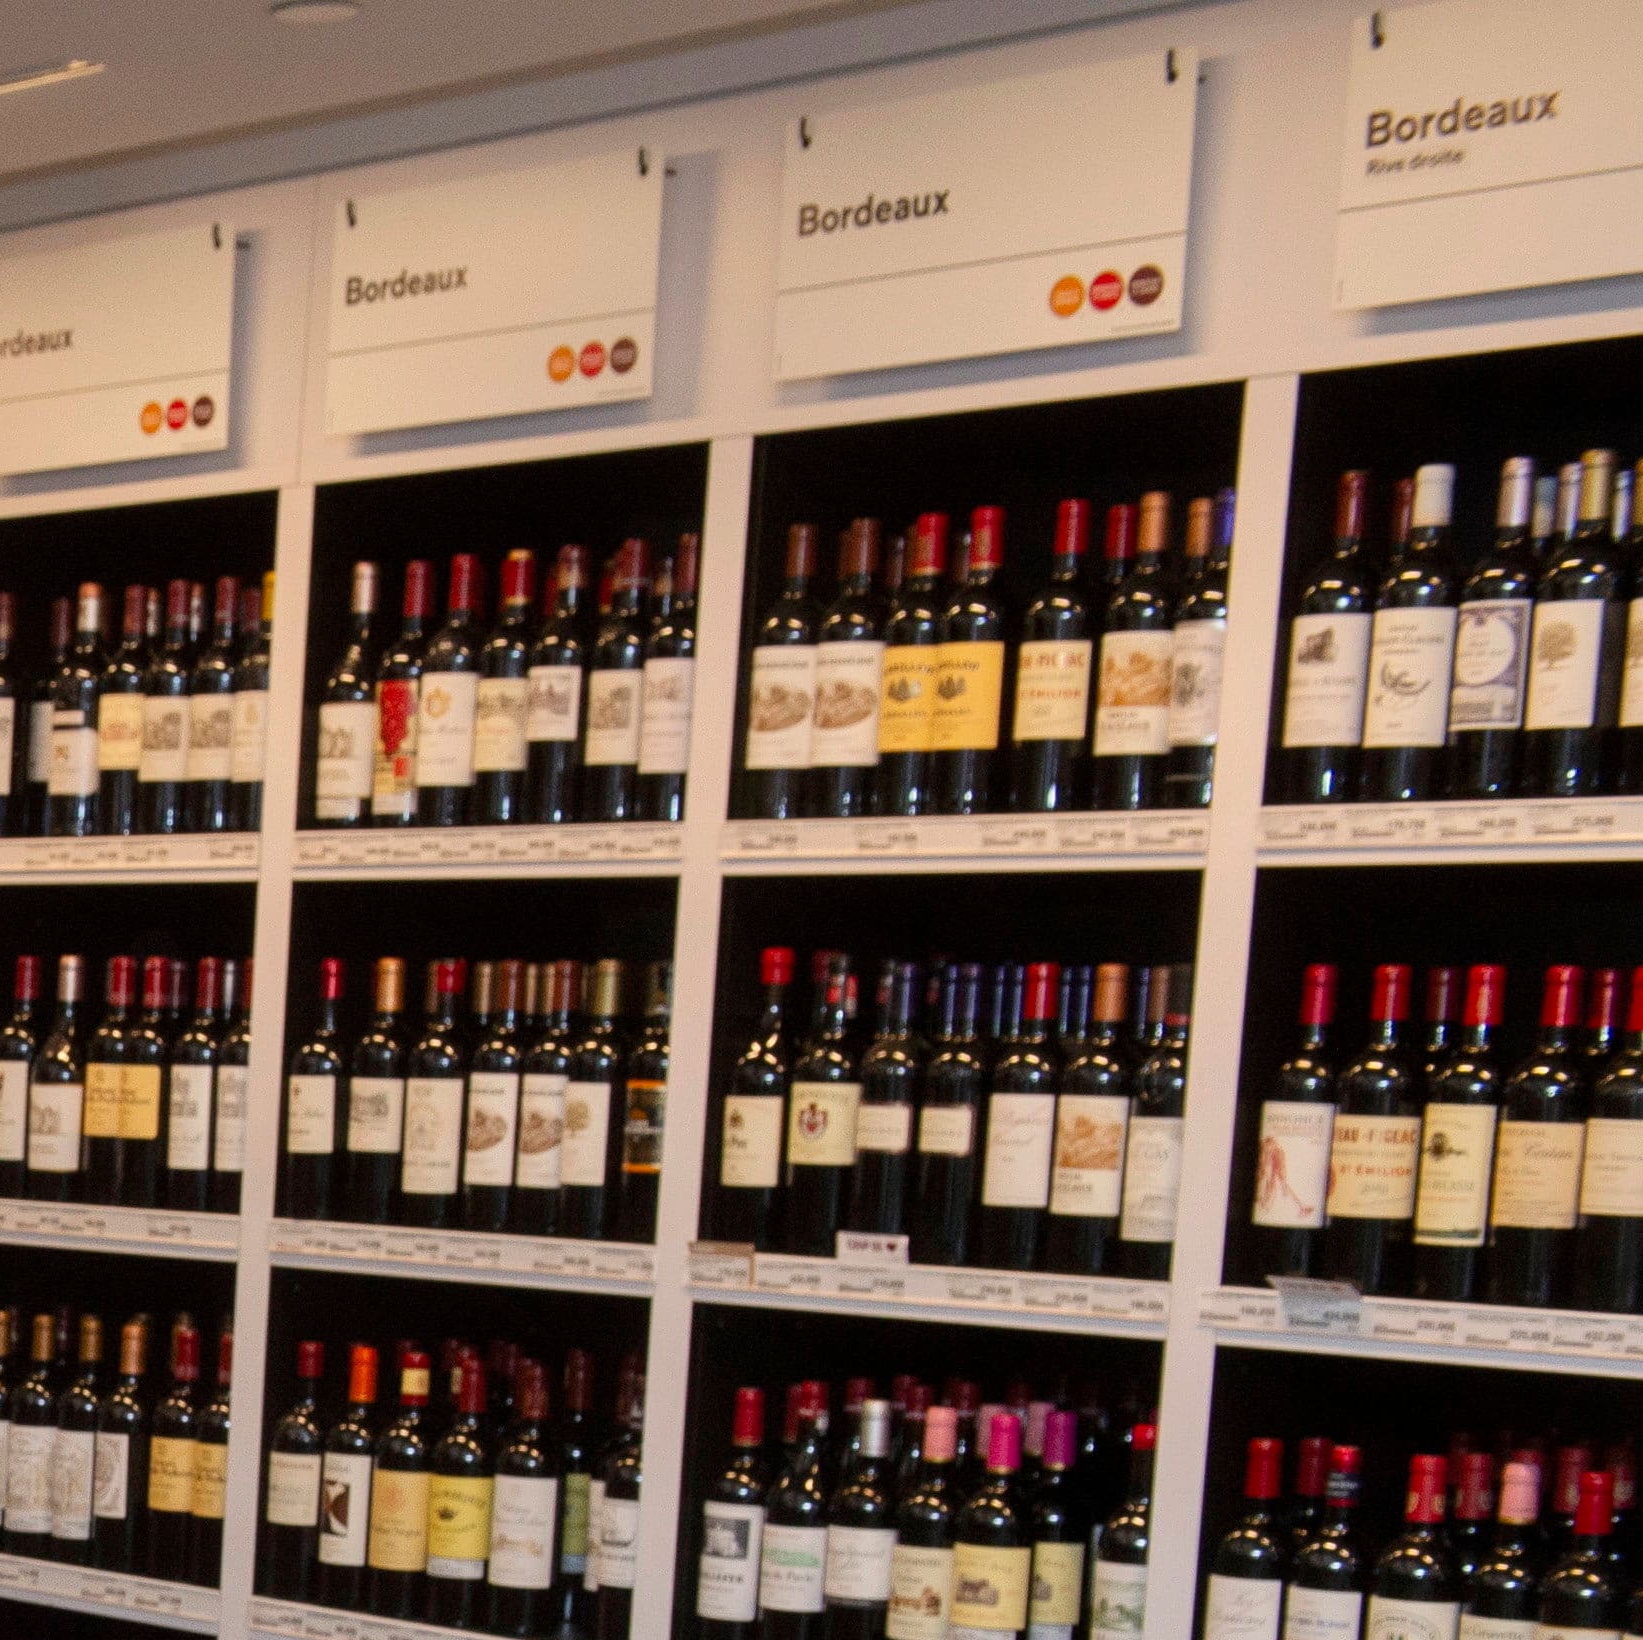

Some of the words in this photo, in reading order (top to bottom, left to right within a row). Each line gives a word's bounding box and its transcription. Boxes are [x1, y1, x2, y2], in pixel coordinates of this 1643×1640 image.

[1366, 91, 1562, 149] Bordeaux
[798, 189, 950, 237] Bordeaux
[345, 266, 468, 305] Bordeaux
